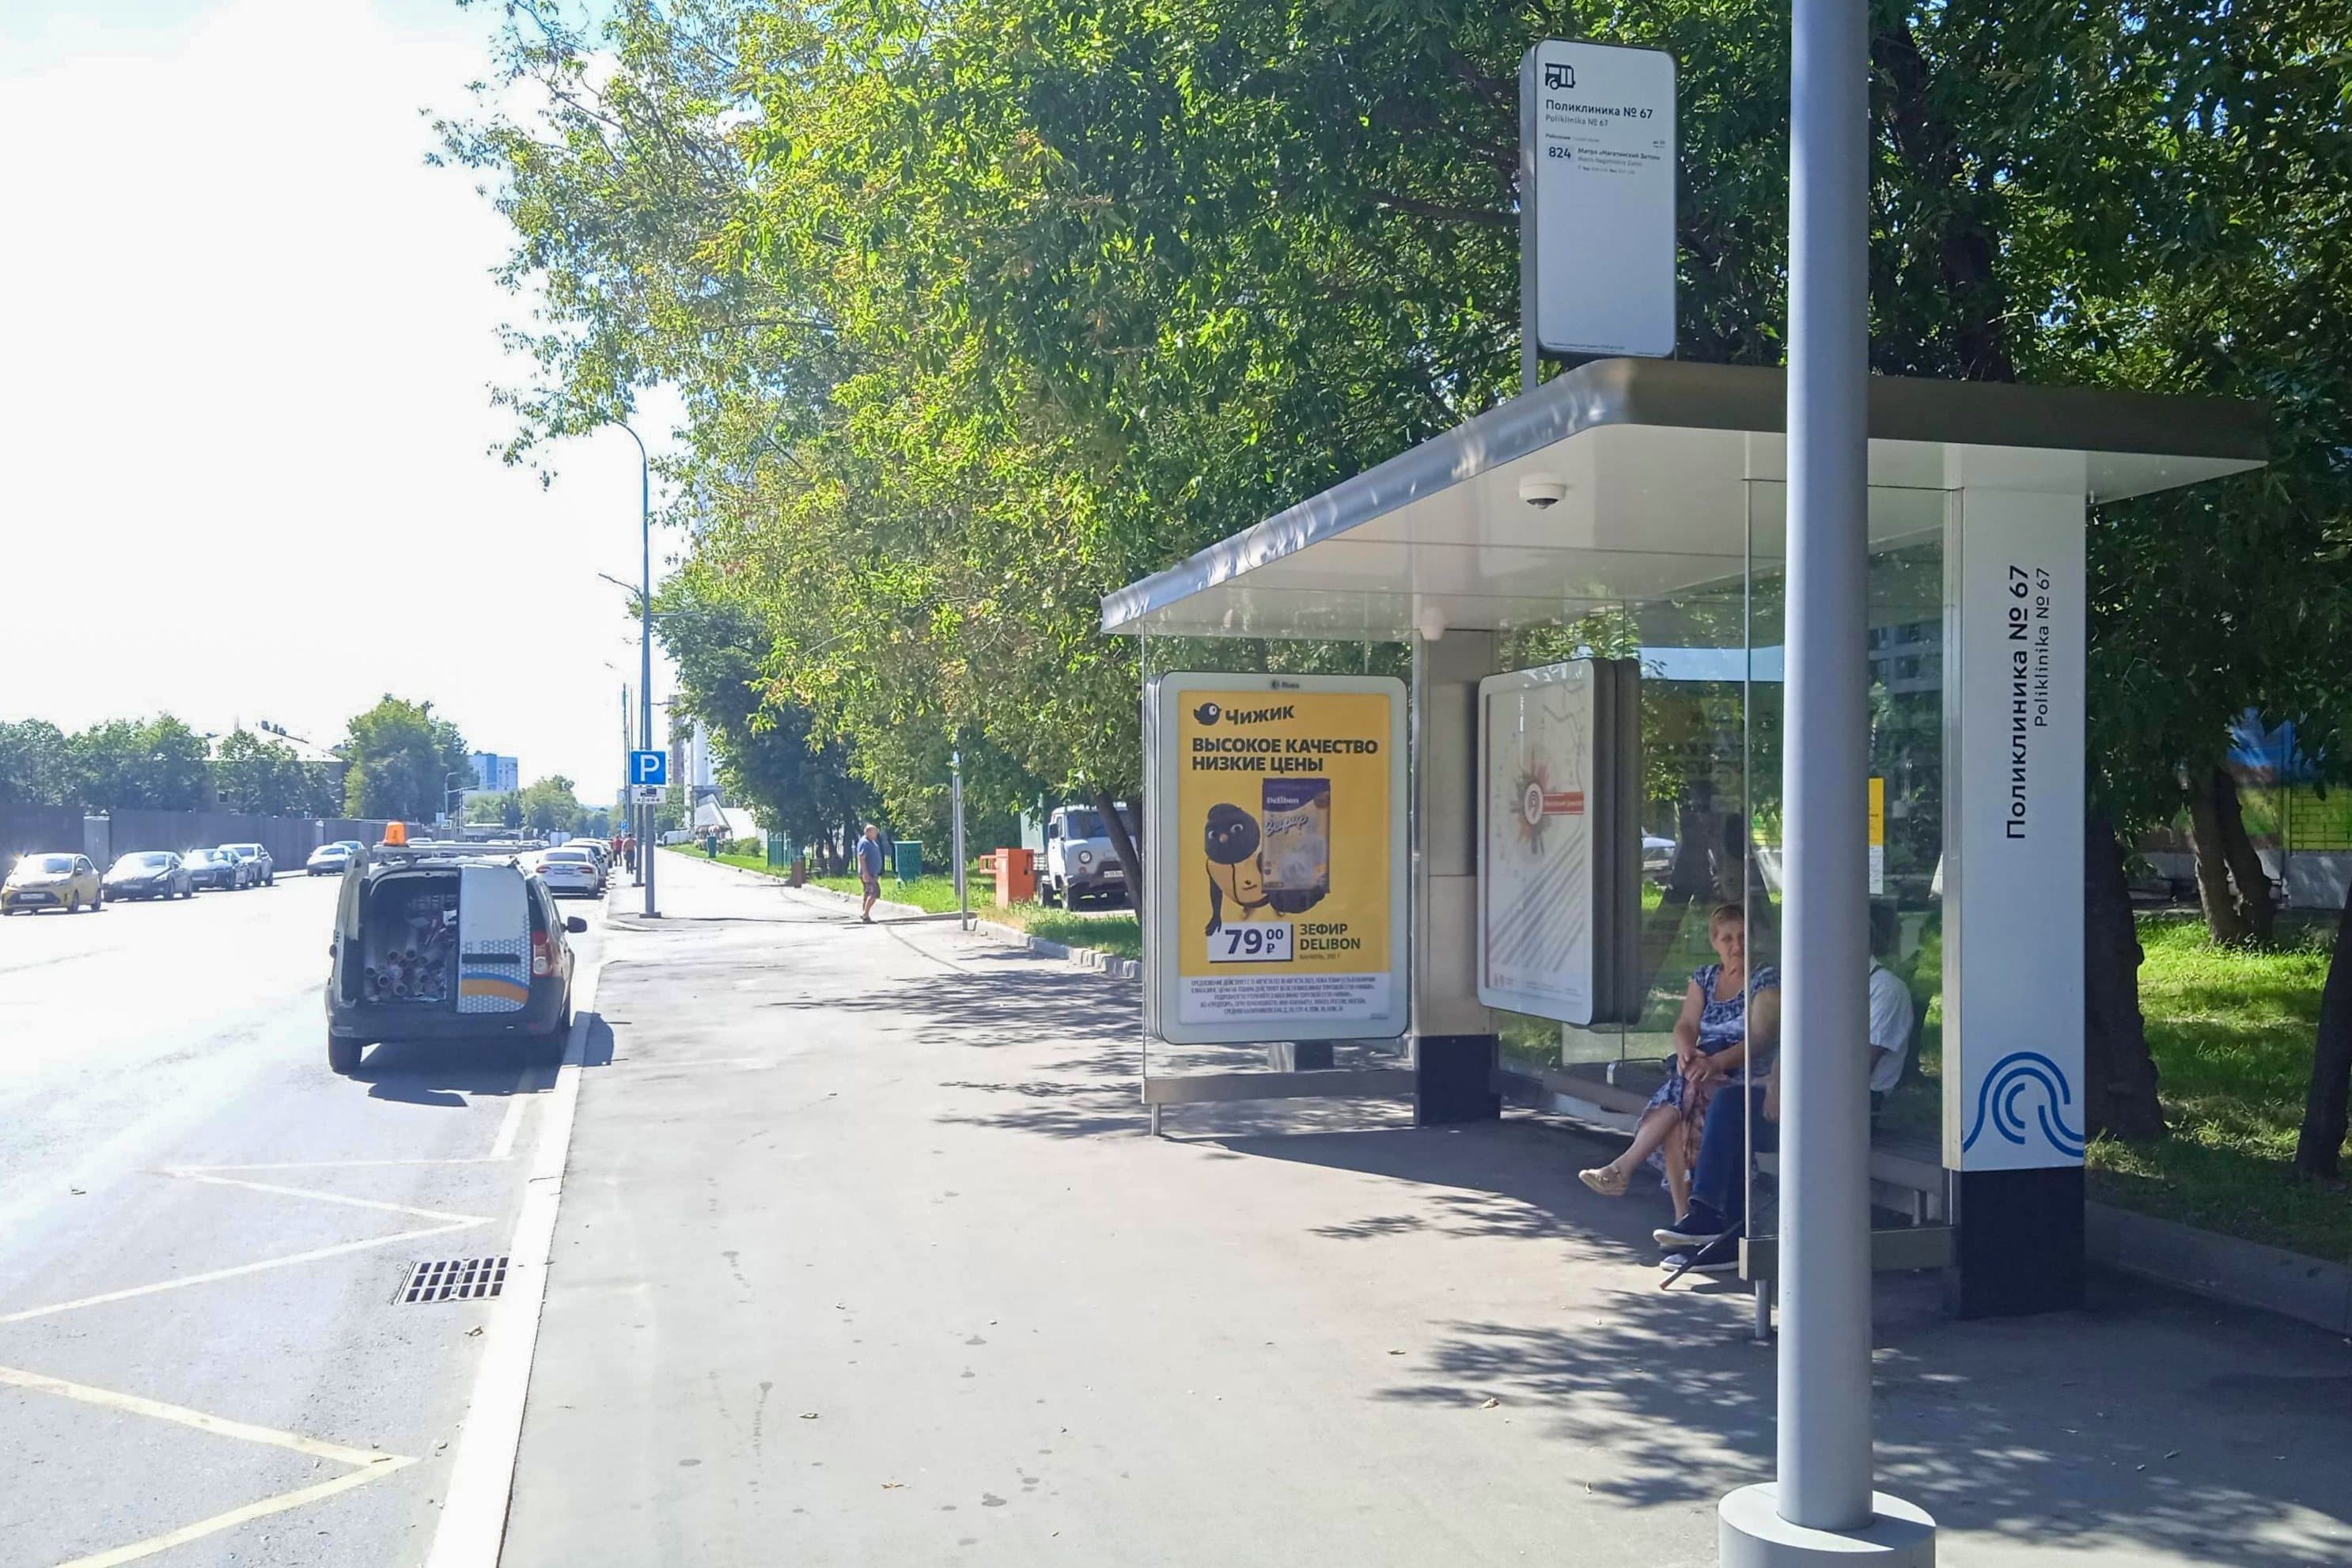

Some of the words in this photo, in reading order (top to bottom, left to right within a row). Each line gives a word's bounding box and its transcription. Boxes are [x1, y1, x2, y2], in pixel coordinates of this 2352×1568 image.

[1546, 99, 1620, 116] Поликлиника
[1623, 107, 1637, 118] №
[1639, 108, 1653, 119] 67
[1546, 114, 1586, 125] Poliklinika
[1548, 146, 1571, 158] 824
[2009, 565, 2028, 599] 67
[2036, 567, 2050, 591] 67
[2036, 596, 2050, 619] №
[2009, 607, 2028, 640] №
[2034, 626, 2049, 727] Poliklinika
[1192, 737, 1282, 752] ВЫСОКОЕ
[1286, 739, 1378, 755] КАЧЕСТВО
[2006, 650, 2028, 839] Поликлиника
[640, 754, 660, 782] P
[1192, 756, 1266, 771] НИЗКИЕ
[1271, 757, 1323, 774] ЦЕНЫ
[1267, 796, 1299, 805] Delibon
[1300, 923, 1348, 936] ЗЕФИР
[1225, 929, 1263, 955] 79
[1266, 929, 1284, 940] 00
[1300, 938, 1361, 950] DELIBON
